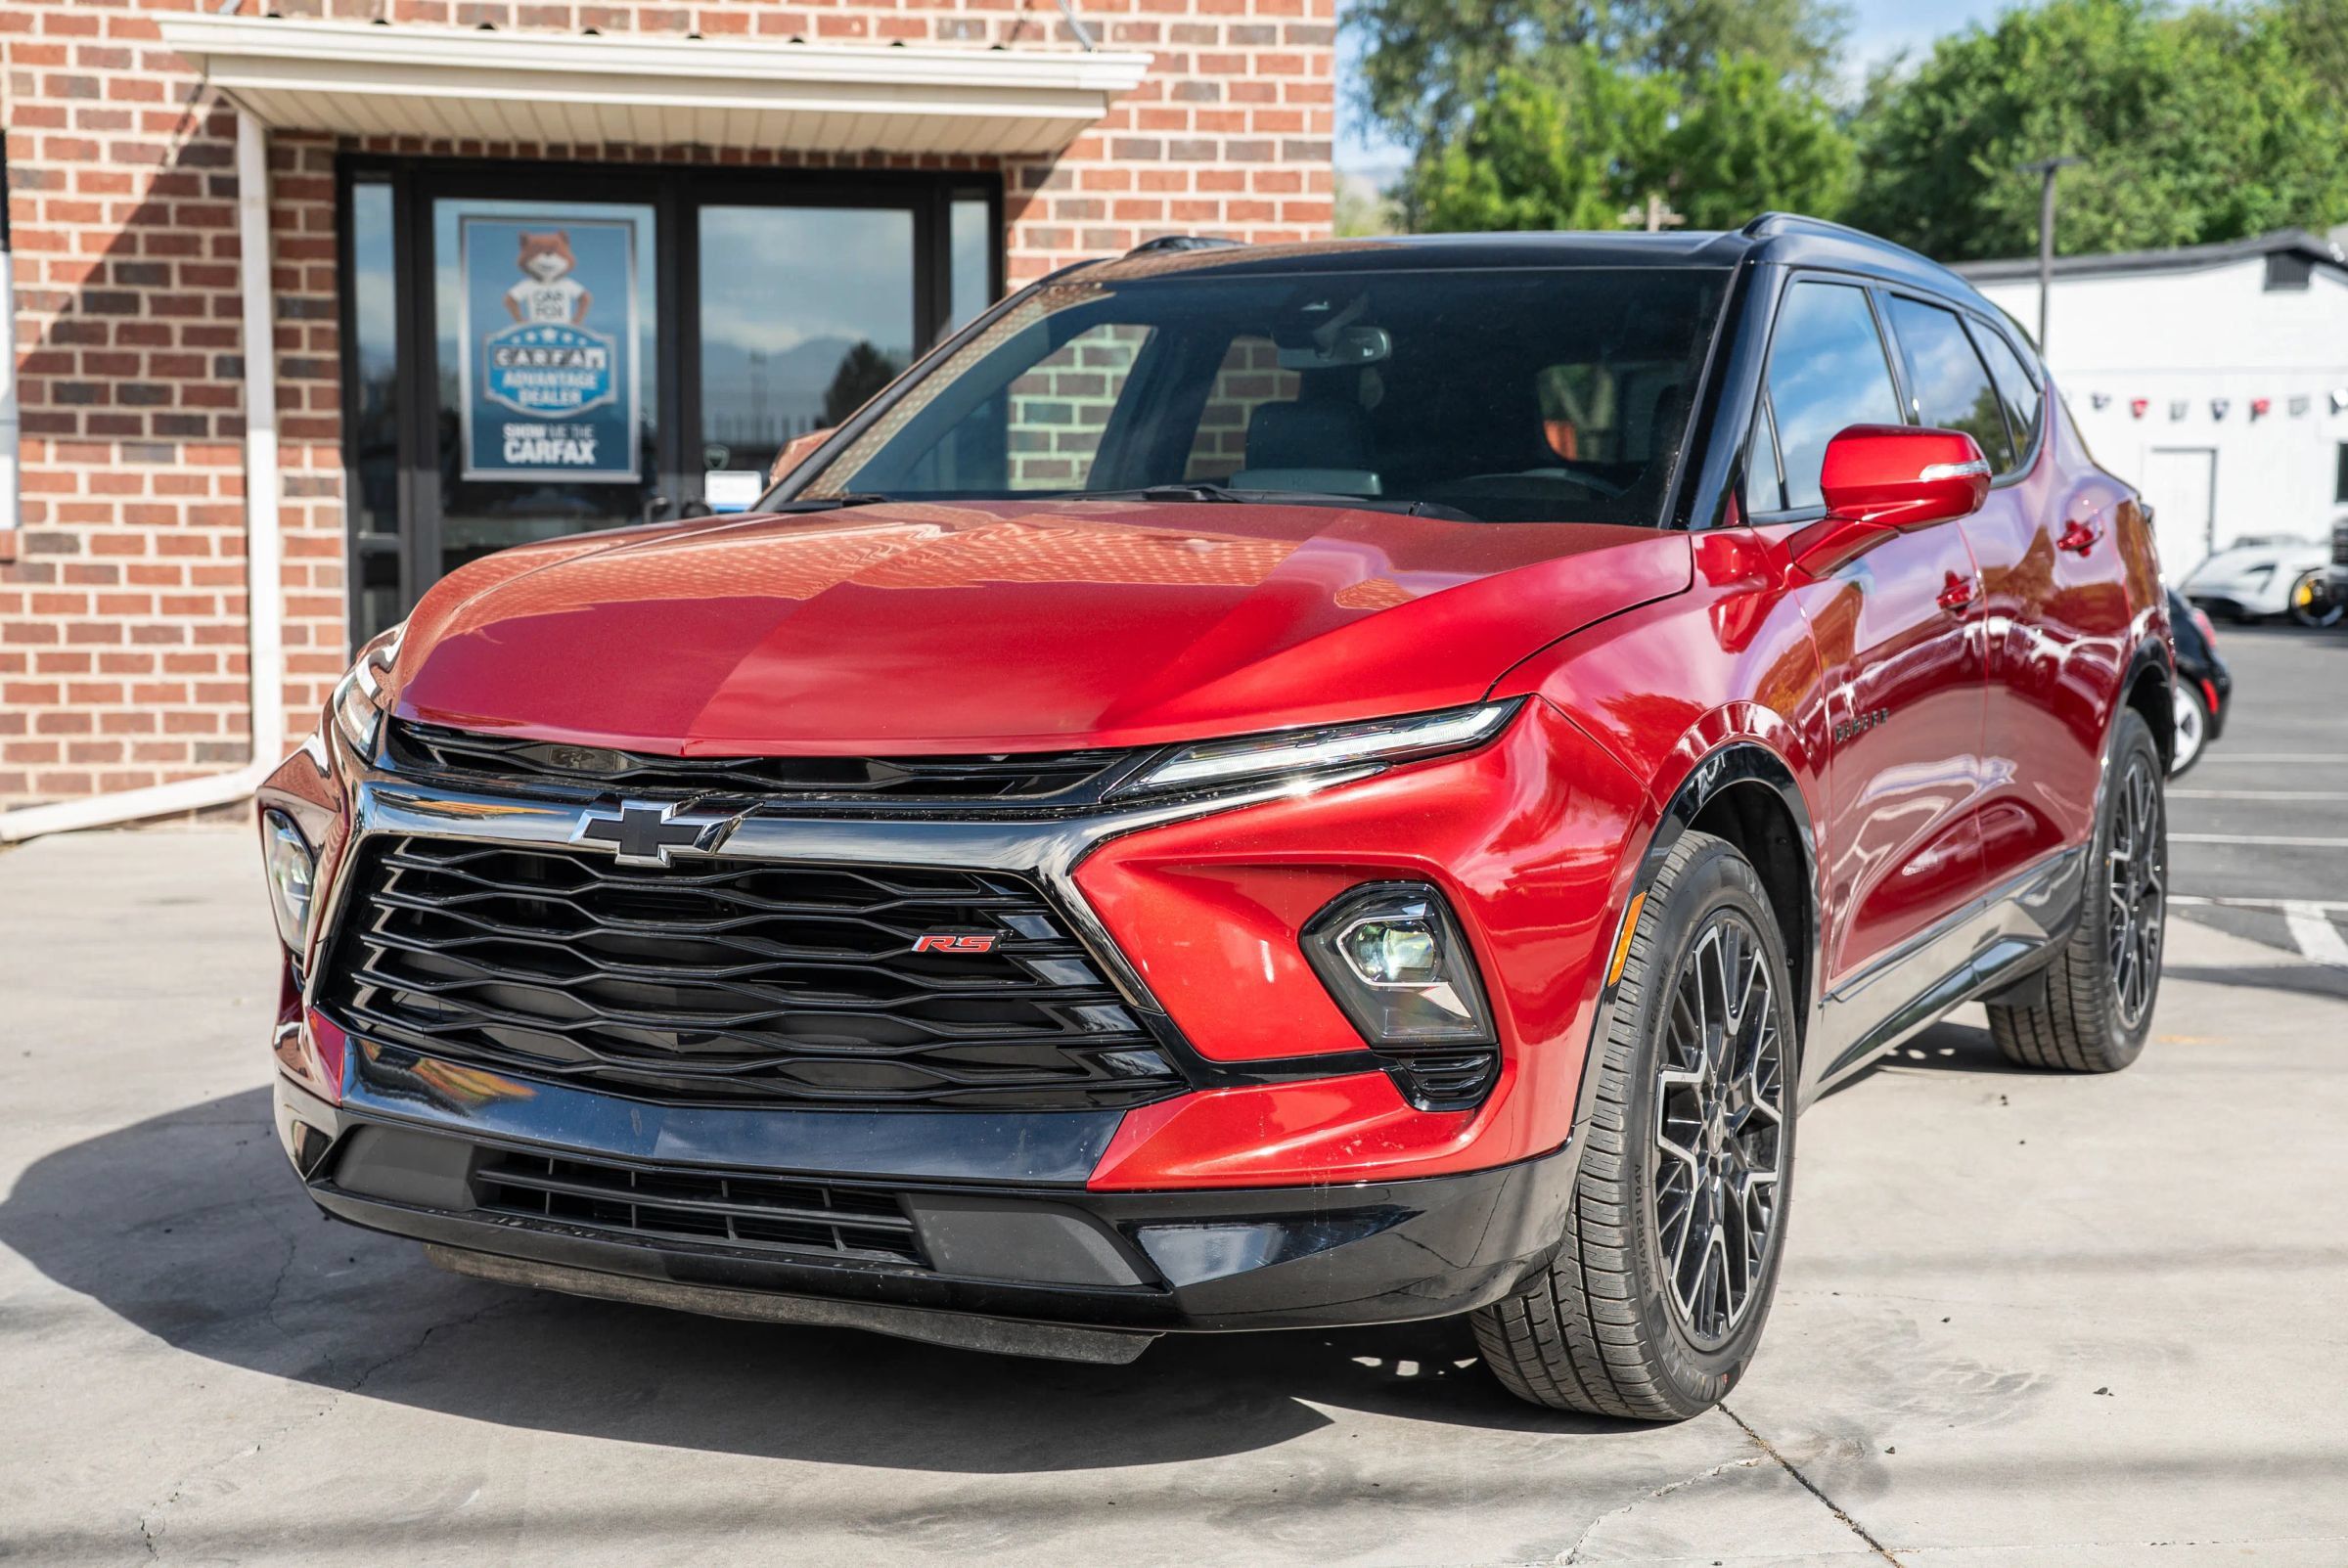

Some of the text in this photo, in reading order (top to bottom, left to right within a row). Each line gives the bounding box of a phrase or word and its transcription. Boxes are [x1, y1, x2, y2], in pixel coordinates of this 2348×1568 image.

[502, 371, 598, 388] ADVANTAGE
[519, 387, 582, 406] DEALER
[503, 423, 594, 438] SHOW ME THE
[503, 439, 596, 464] CARFAX
[911, 935, 996, 952] RS
[1635, 1208, 1652, 1297] 265/45R21
